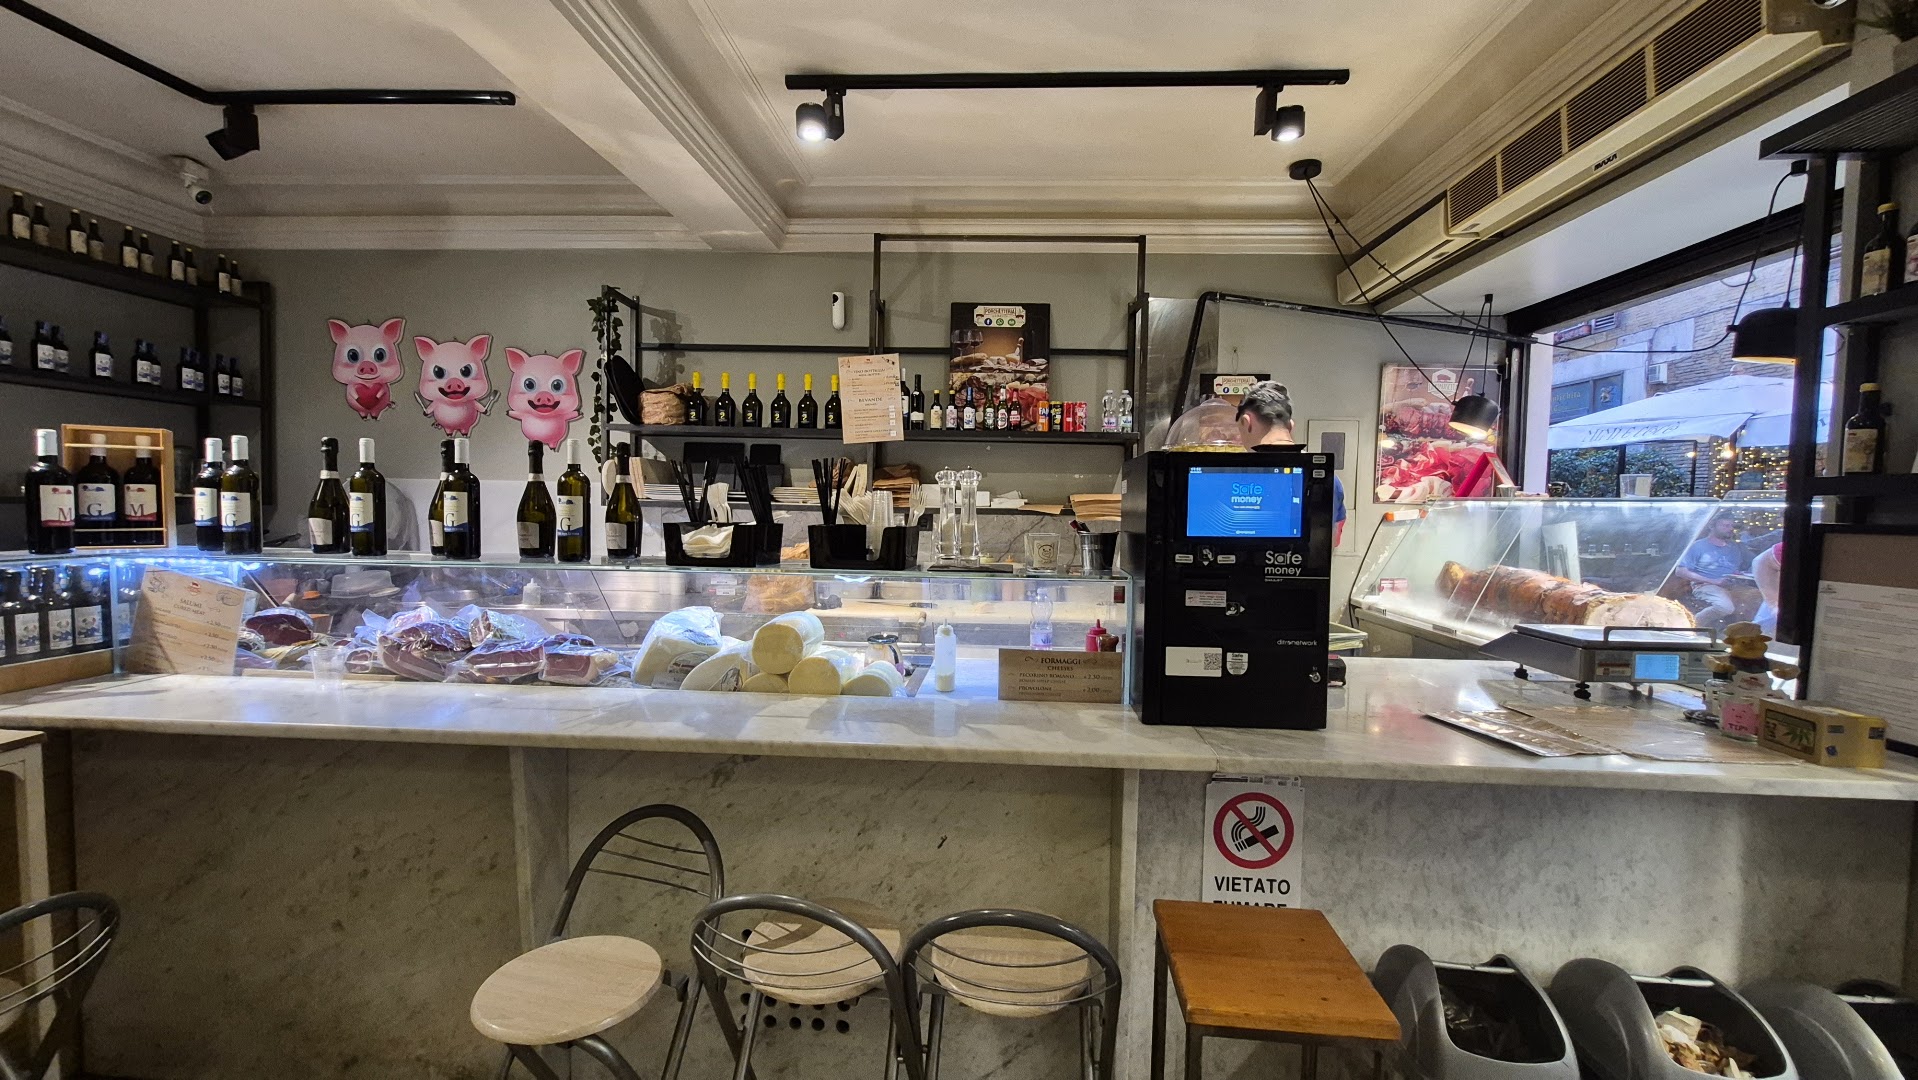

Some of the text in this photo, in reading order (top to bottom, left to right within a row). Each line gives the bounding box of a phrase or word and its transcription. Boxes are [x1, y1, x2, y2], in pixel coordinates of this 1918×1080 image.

[1231, 483, 1263, 495] Safe
[1231, 495, 1263, 505] money
[58, 507, 73, 521] M
[86, 503, 103, 516] G
[129, 503, 145, 516] M
[225, 513, 238, 527] G
[352, 513, 360, 527] G
[446, 513, 455, 527] G
[560, 517, 571, 531] G
[1265, 550, 1303, 565] Safe
[1264, 566, 1302, 577] money
[1041, 657, 1081, 665] FORMAGGI
[1214, 875, 1291, 895] VIETATO
